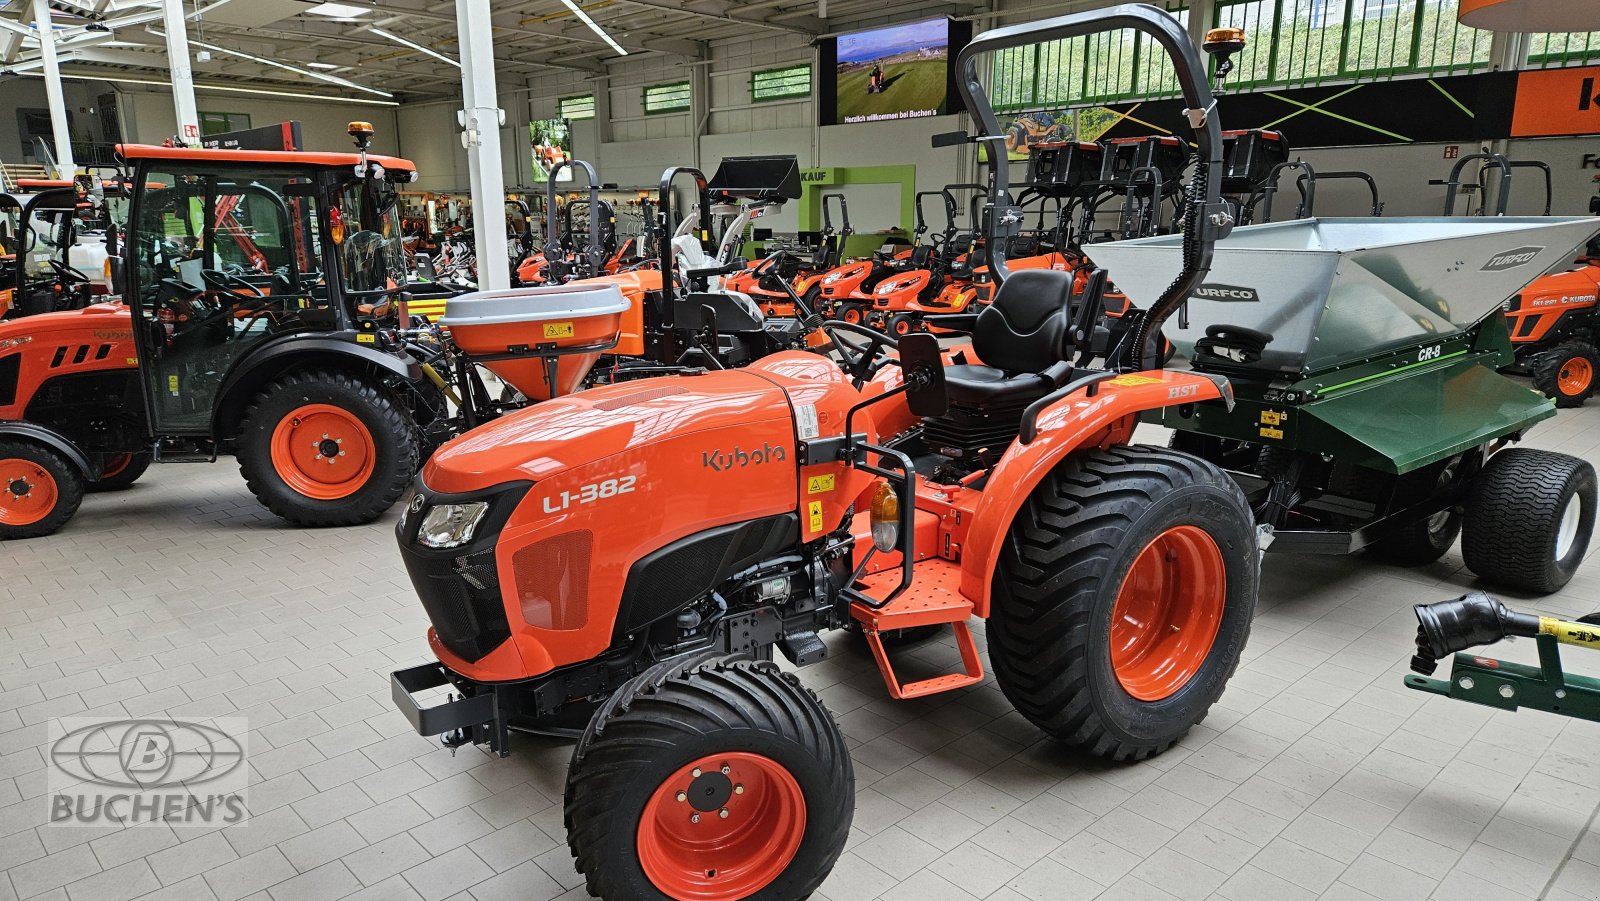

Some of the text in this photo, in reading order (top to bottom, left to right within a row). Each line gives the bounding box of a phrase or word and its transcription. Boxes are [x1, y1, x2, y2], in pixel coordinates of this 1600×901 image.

[844, 114, 866, 123] Herzlich
[867, 112, 898, 122] willkommen
[899, 110, 908, 119] bei
[800, 171, 826, 181] KAUF
[1488, 251, 1536, 267] TURFCO
[1196, 287, 1253, 299] URFCO
[1417, 345, 1441, 361] CR-8
[1168, 384, 1200, 399] HST
[702, 442, 786, 472] Kubota
[543, 475, 637, 514] L1-382
